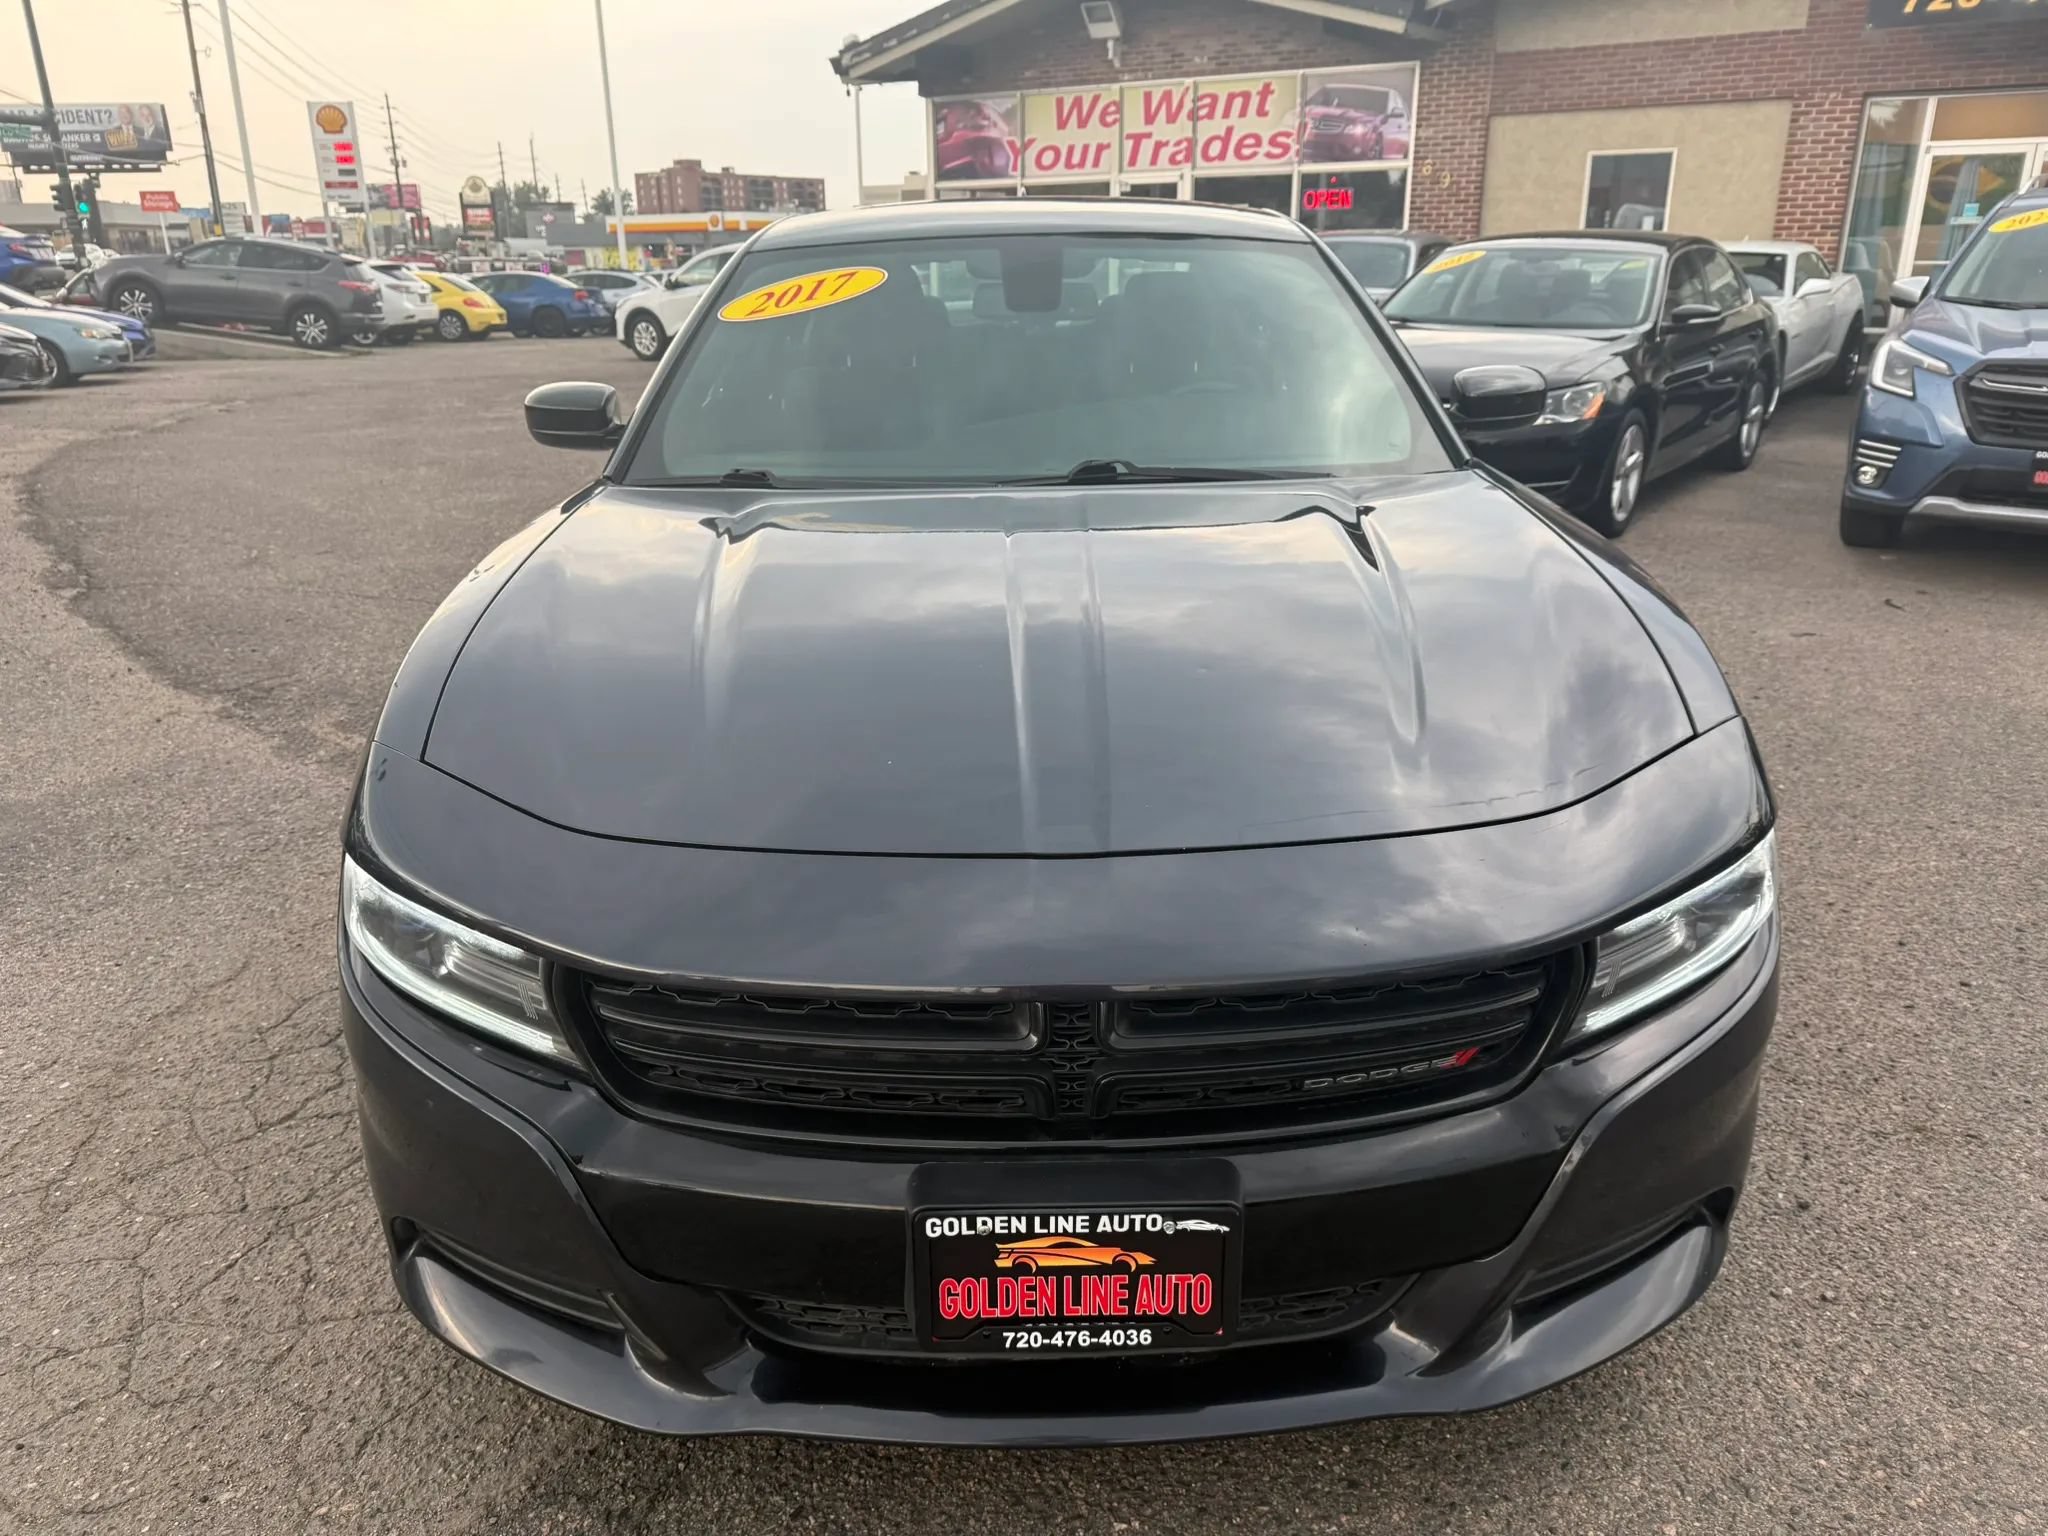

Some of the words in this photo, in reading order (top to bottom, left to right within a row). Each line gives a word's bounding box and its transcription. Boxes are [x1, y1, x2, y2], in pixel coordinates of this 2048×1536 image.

[1054, 92, 1121, 131] We
[1144, 80, 1275, 126] Want
[1005, 136, 1110, 173] Your
[1125, 120, 1309, 169] Trades!
[1303, 187, 1354, 210] OPEN
[2005, 210, 2048, 230] 202
[744, 271, 859, 317] 2017
[1303, 1057, 1457, 1091] DODGE
[925, 1217, 1027, 1238] GOLDEN
[1034, 1215, 1090, 1235] LINE
[1097, 1213, 1163, 1234] AUTO
[938, 1275, 1058, 1320] GOLDEN
[1062, 1274, 1130, 1317] LINE
[1134, 1273, 1213, 1316] AUTO
[1002, 1328, 1153, 1349] 720-476-4036
